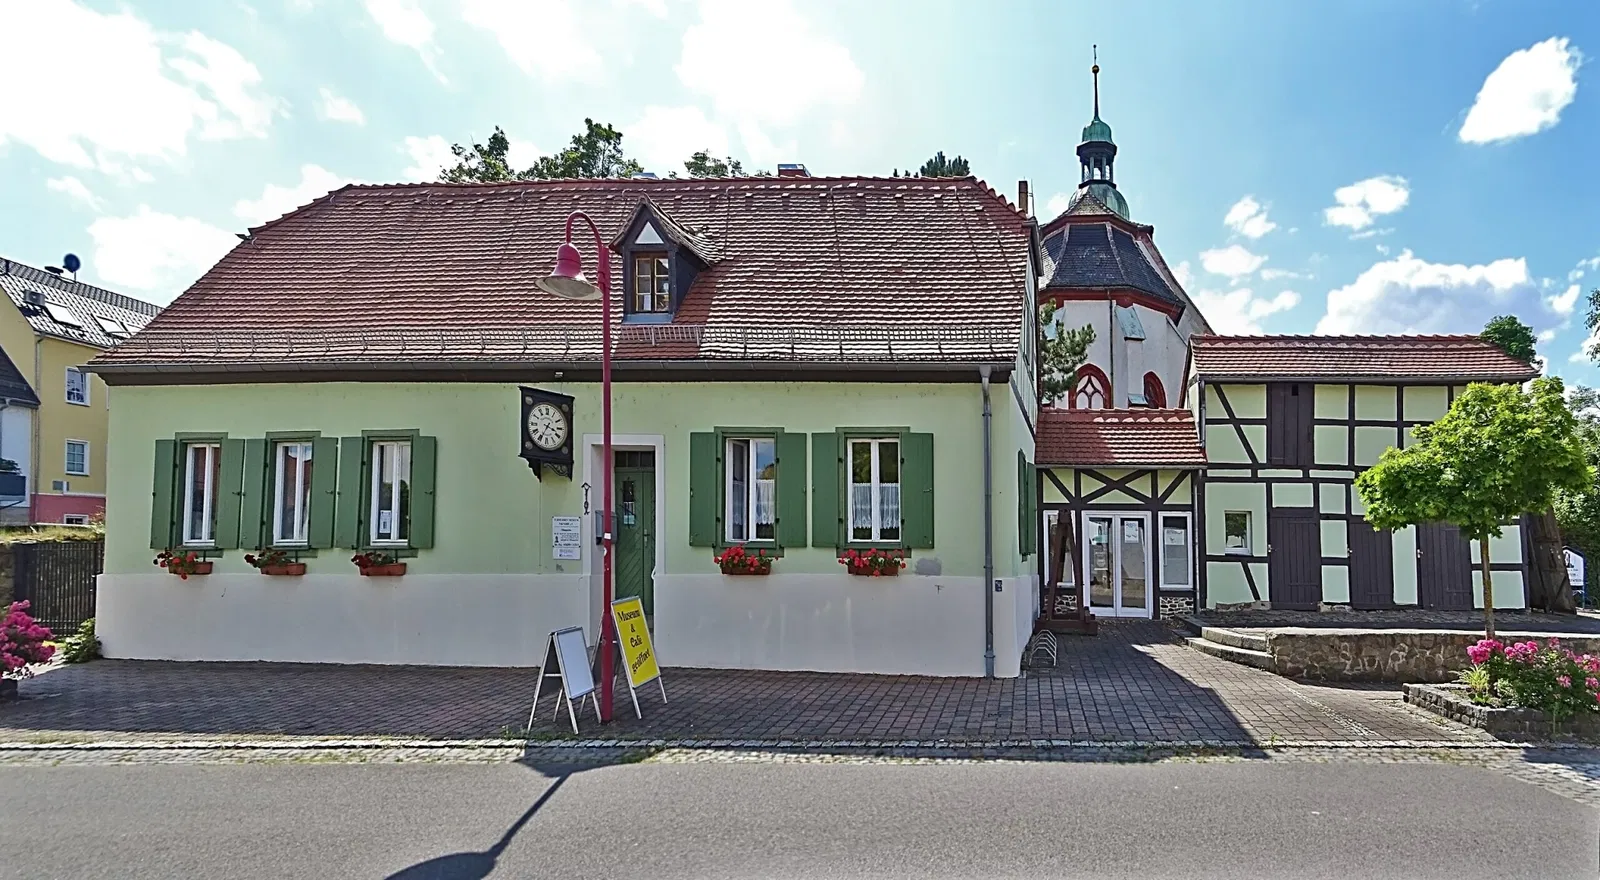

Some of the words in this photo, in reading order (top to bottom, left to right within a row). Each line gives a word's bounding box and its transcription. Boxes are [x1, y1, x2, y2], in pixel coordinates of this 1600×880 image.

[617, 609, 641, 622] Museum
[630, 623, 636, 633] &
[631, 648, 651, 675] geöffnet
